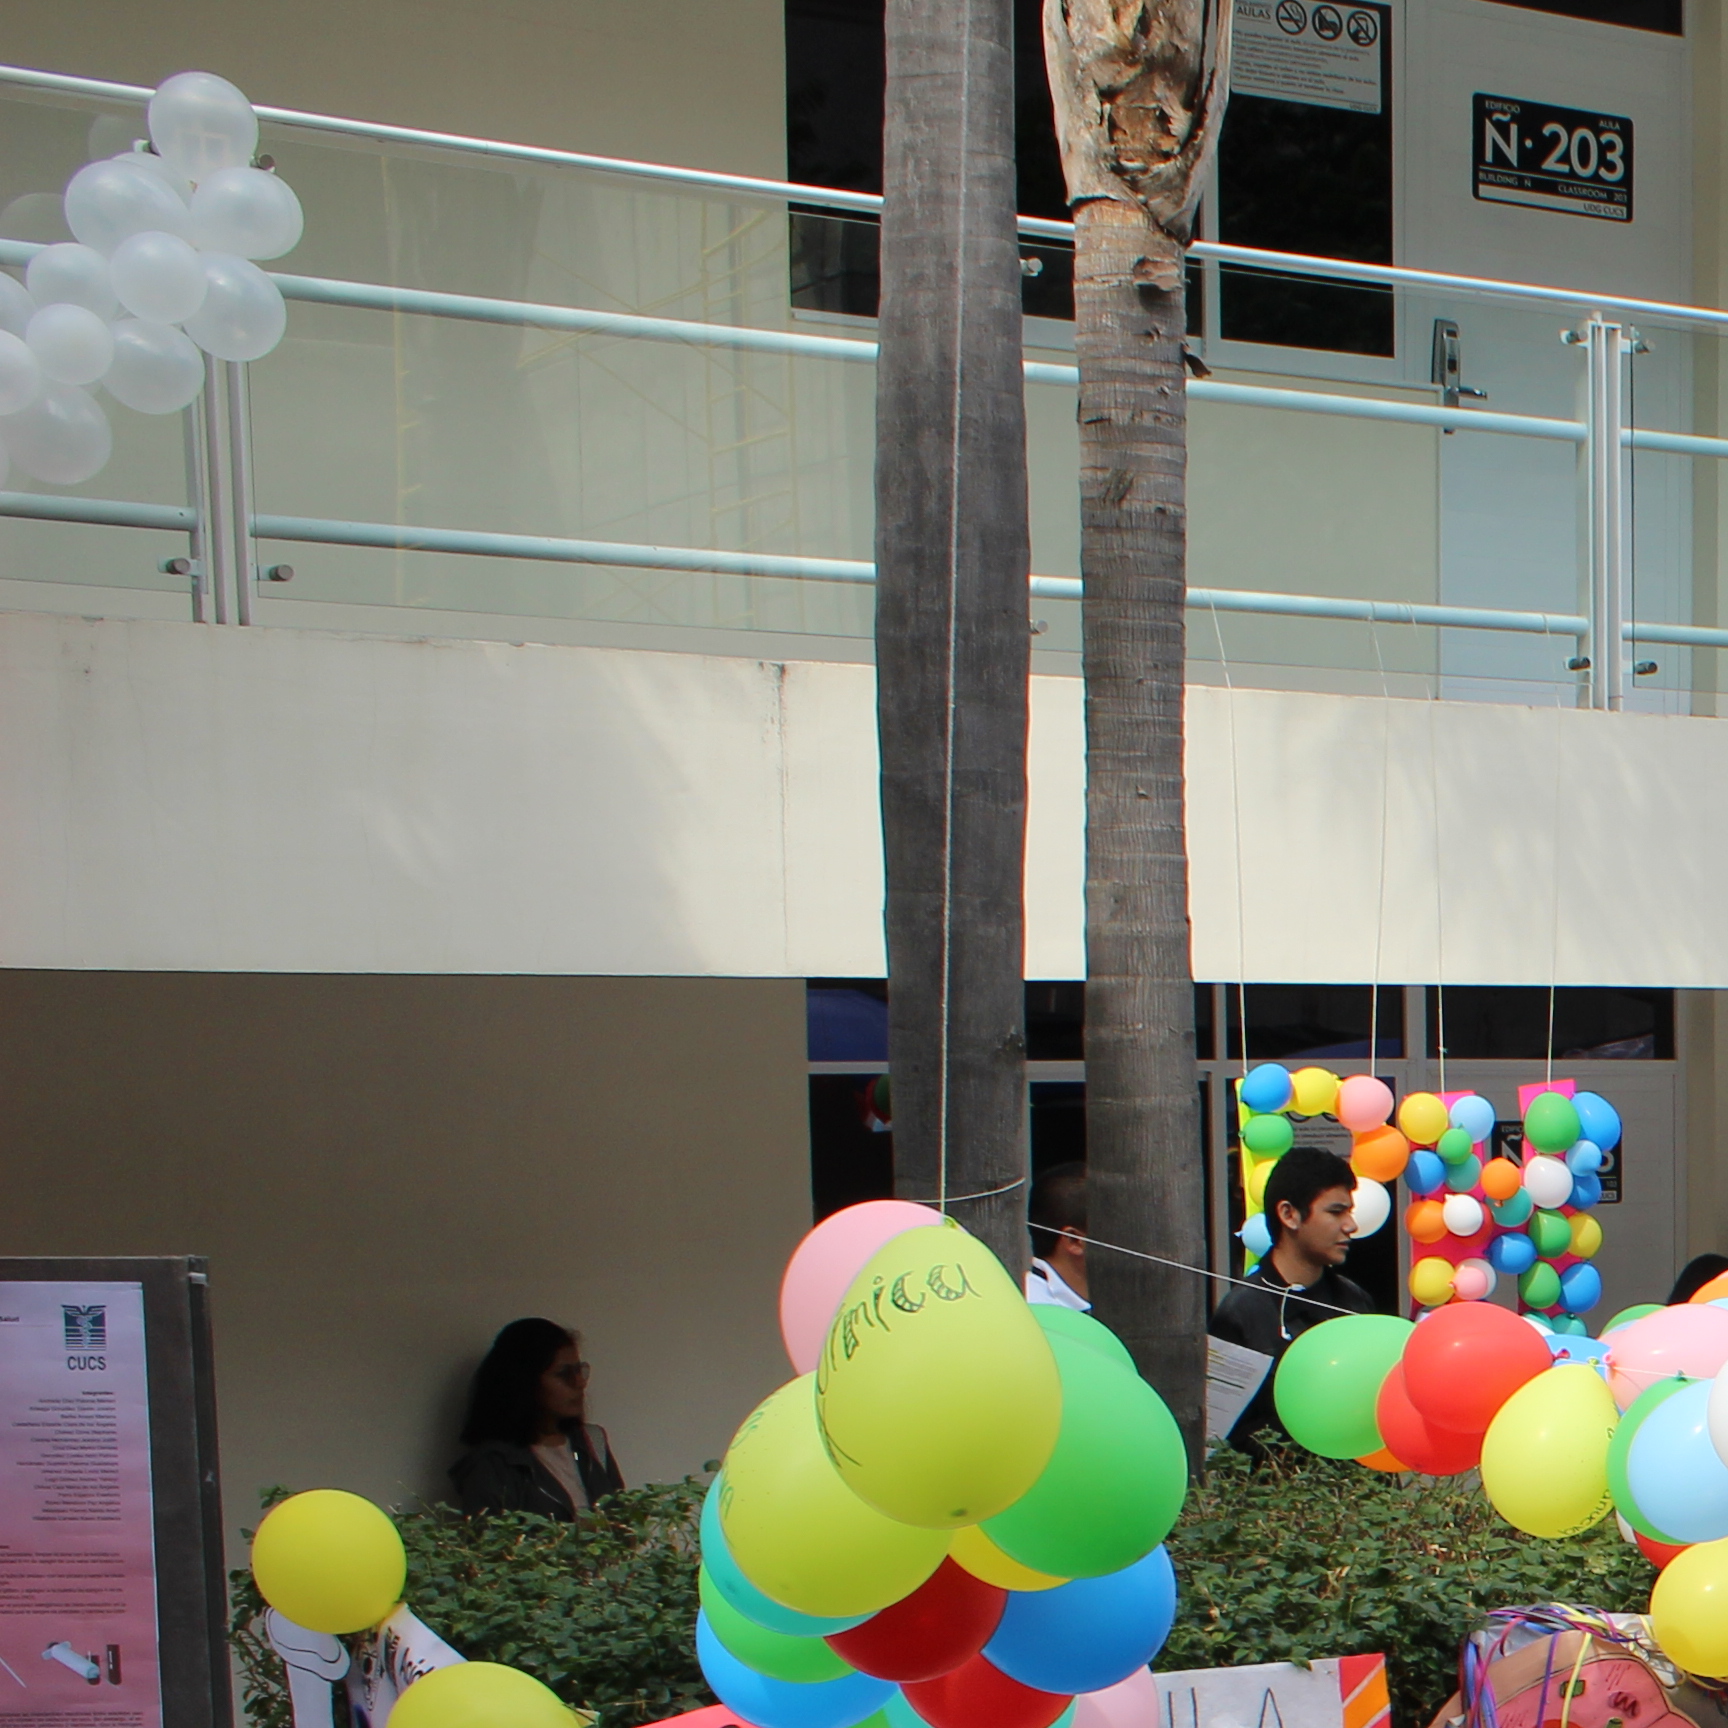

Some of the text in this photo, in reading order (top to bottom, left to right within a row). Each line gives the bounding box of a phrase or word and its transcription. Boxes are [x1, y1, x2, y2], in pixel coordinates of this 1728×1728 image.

[1236, 5, 1271, 20] AULAS
[1485, 100, 1521, 114] EDIFICIO
[1598, 119, 1621, 131] AULA
[1478, 171, 1518, 187] BUILDING
[1557, 184, 1608, 200] CLASSROOM
[1583, 202, 1625, 217] UDG CUCS
[67, 1355, 107, 1371] CUCS
